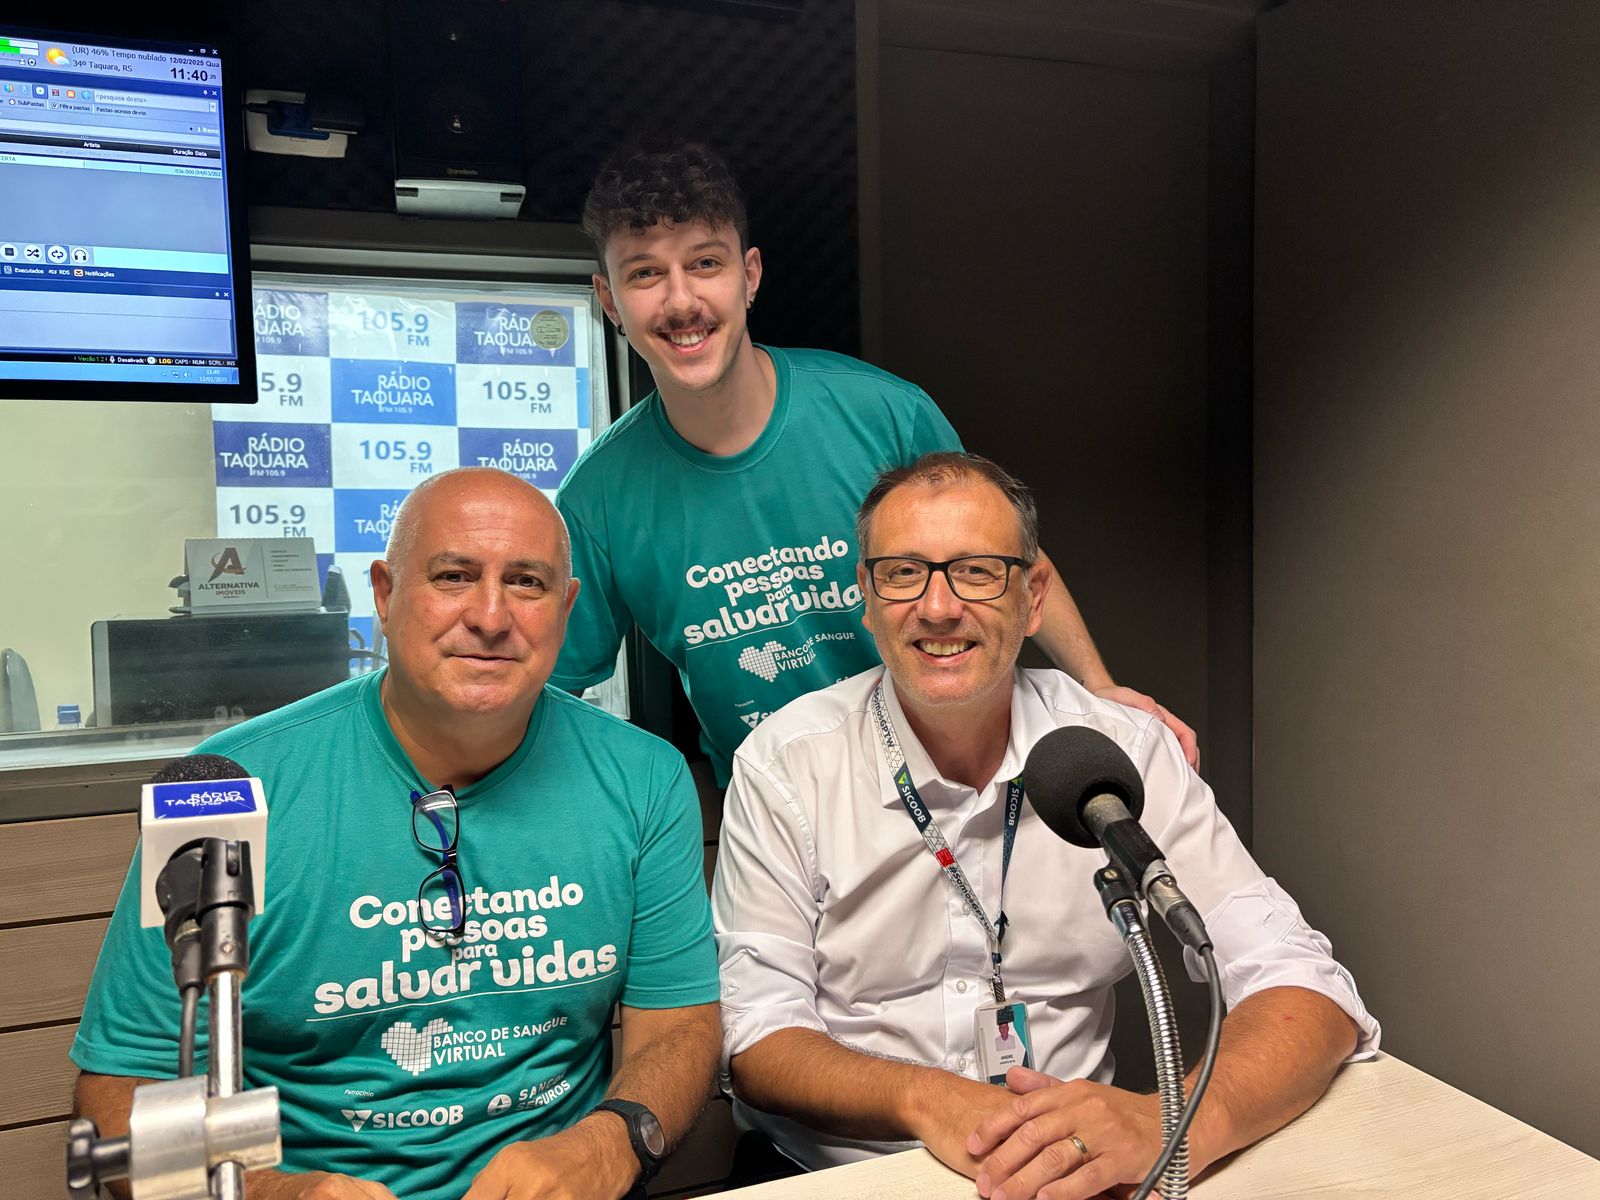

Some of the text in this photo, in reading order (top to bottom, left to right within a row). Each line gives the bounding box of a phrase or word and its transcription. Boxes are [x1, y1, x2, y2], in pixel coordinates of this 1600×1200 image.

[72, 46, 166, 62] (UR) 46% Tempo nublado
[89, 62, 120, 72] Taquara,
[123, 64, 133, 72] RS
[171, 68, 208, 82] 11:40
[254, 298, 302, 320] ÁDIO
[255, 320, 305, 336] UARA
[358, 310, 429, 333] 105.9
[499, 312, 531, 332] RÁD
[407, 334, 430, 347] FM
[473, 331, 537, 348] TAQUA
[260, 371, 303, 393] 5.9
[378, 370, 431, 391] RÁDIO
[482, 380, 551, 401] 105.9
[279, 395, 304, 407] FM
[350, 389, 435, 408] TAQUARA
[530, 402, 552, 414] FM
[248, 432, 305, 453] RÁDIO
[359, 440, 432, 461] 105.9
[502, 438, 554, 457] RÁDIO
[219, 452, 309, 470] TAQUARA
[409, 462, 433, 473] FM
[477, 456, 558, 472] TAQUARA
[229, 504, 306, 525] 105.9
[282, 526, 307, 538] FM
[686, 535, 849, 589] Conectando
[198, 581, 260, 590] ALTERNATIVA
[724, 563, 825, 607] pessoas
[765, 584, 794, 604] para
[790, 581, 865, 612] vida
[774, 645, 809, 661] BANCO
[815, 632, 856, 642] SANGUE
[777, 649, 817, 672] VIRTUAL
[163, 795, 246, 807] TAQUARA
[190, 791, 241, 799] RÁDIO
[901, 785, 926, 824] SICOOB
[1008, 788, 1020, 826] SICOOB
[349, 875, 584, 929] Conectando
[400, 914, 548, 963] pessoas
[452, 943, 498, 962] para
[490, 939, 618, 987] vidas
[433, 1016, 568, 1049] BANCO DE SANGUE
[433, 1042, 506, 1066] VIRTUAL
[515, 1080, 571, 1110] SEGUROS
[372, 1104, 464, 1129] SICOOB
